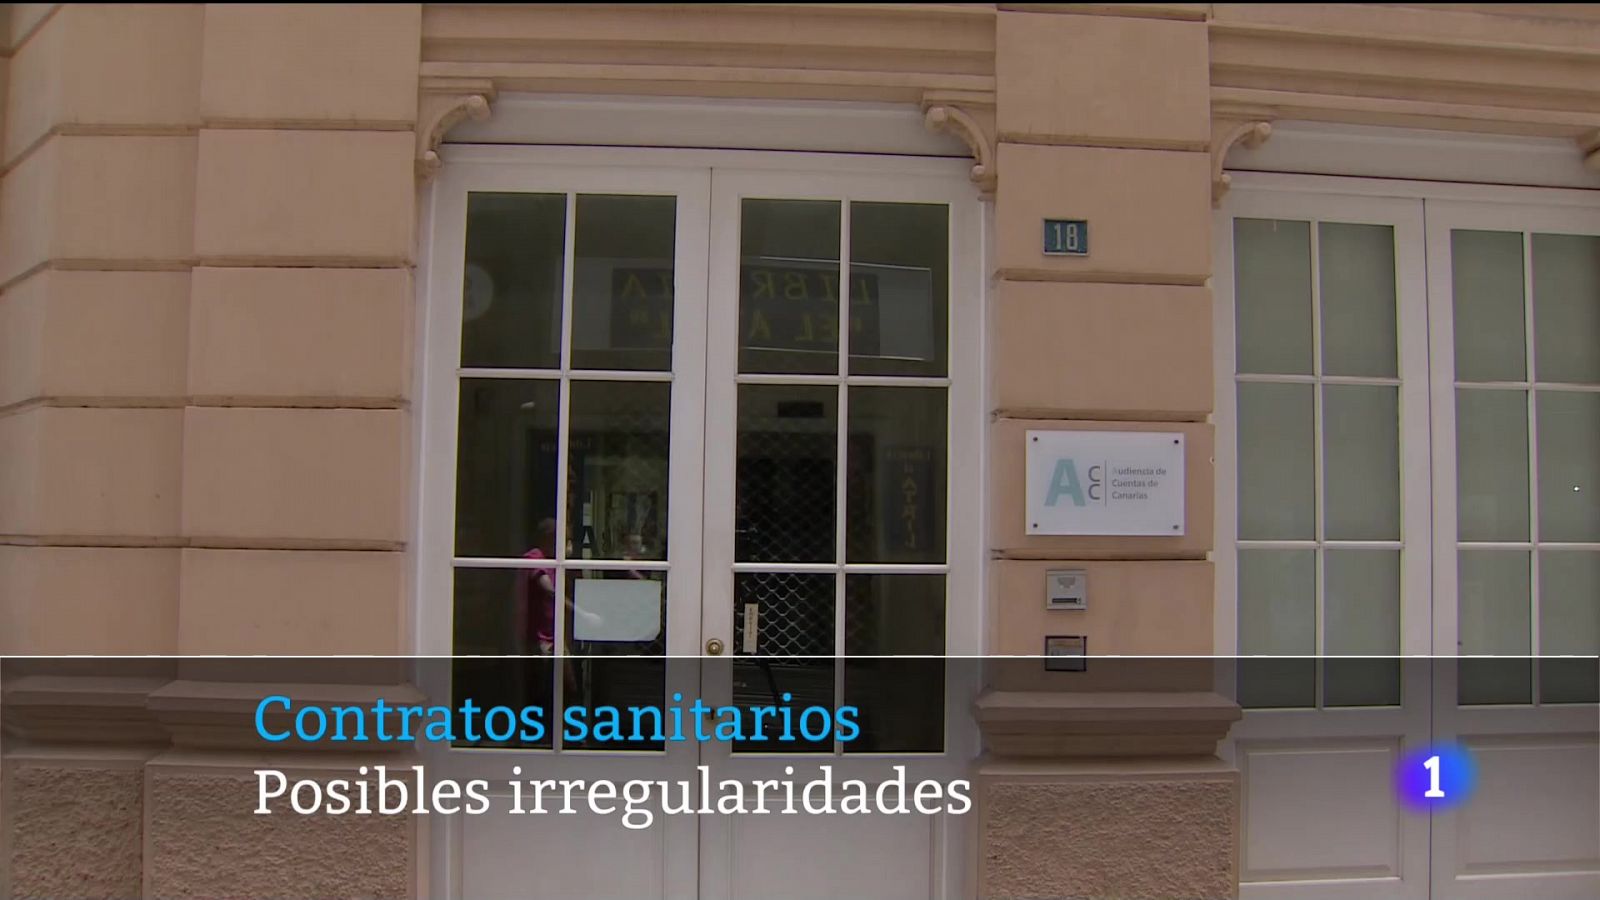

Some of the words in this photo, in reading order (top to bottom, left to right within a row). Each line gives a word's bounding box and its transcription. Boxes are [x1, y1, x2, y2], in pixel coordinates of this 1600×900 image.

[1054, 223, 1079, 250] 18
[1112, 466, 1154, 476] Audiencia
[1155, 466, 1167, 476] de
[1111, 478, 1146, 488] Cuentas
[1147, 479, 1159, 488] de
[1111, 490, 1149, 500] Canarias
